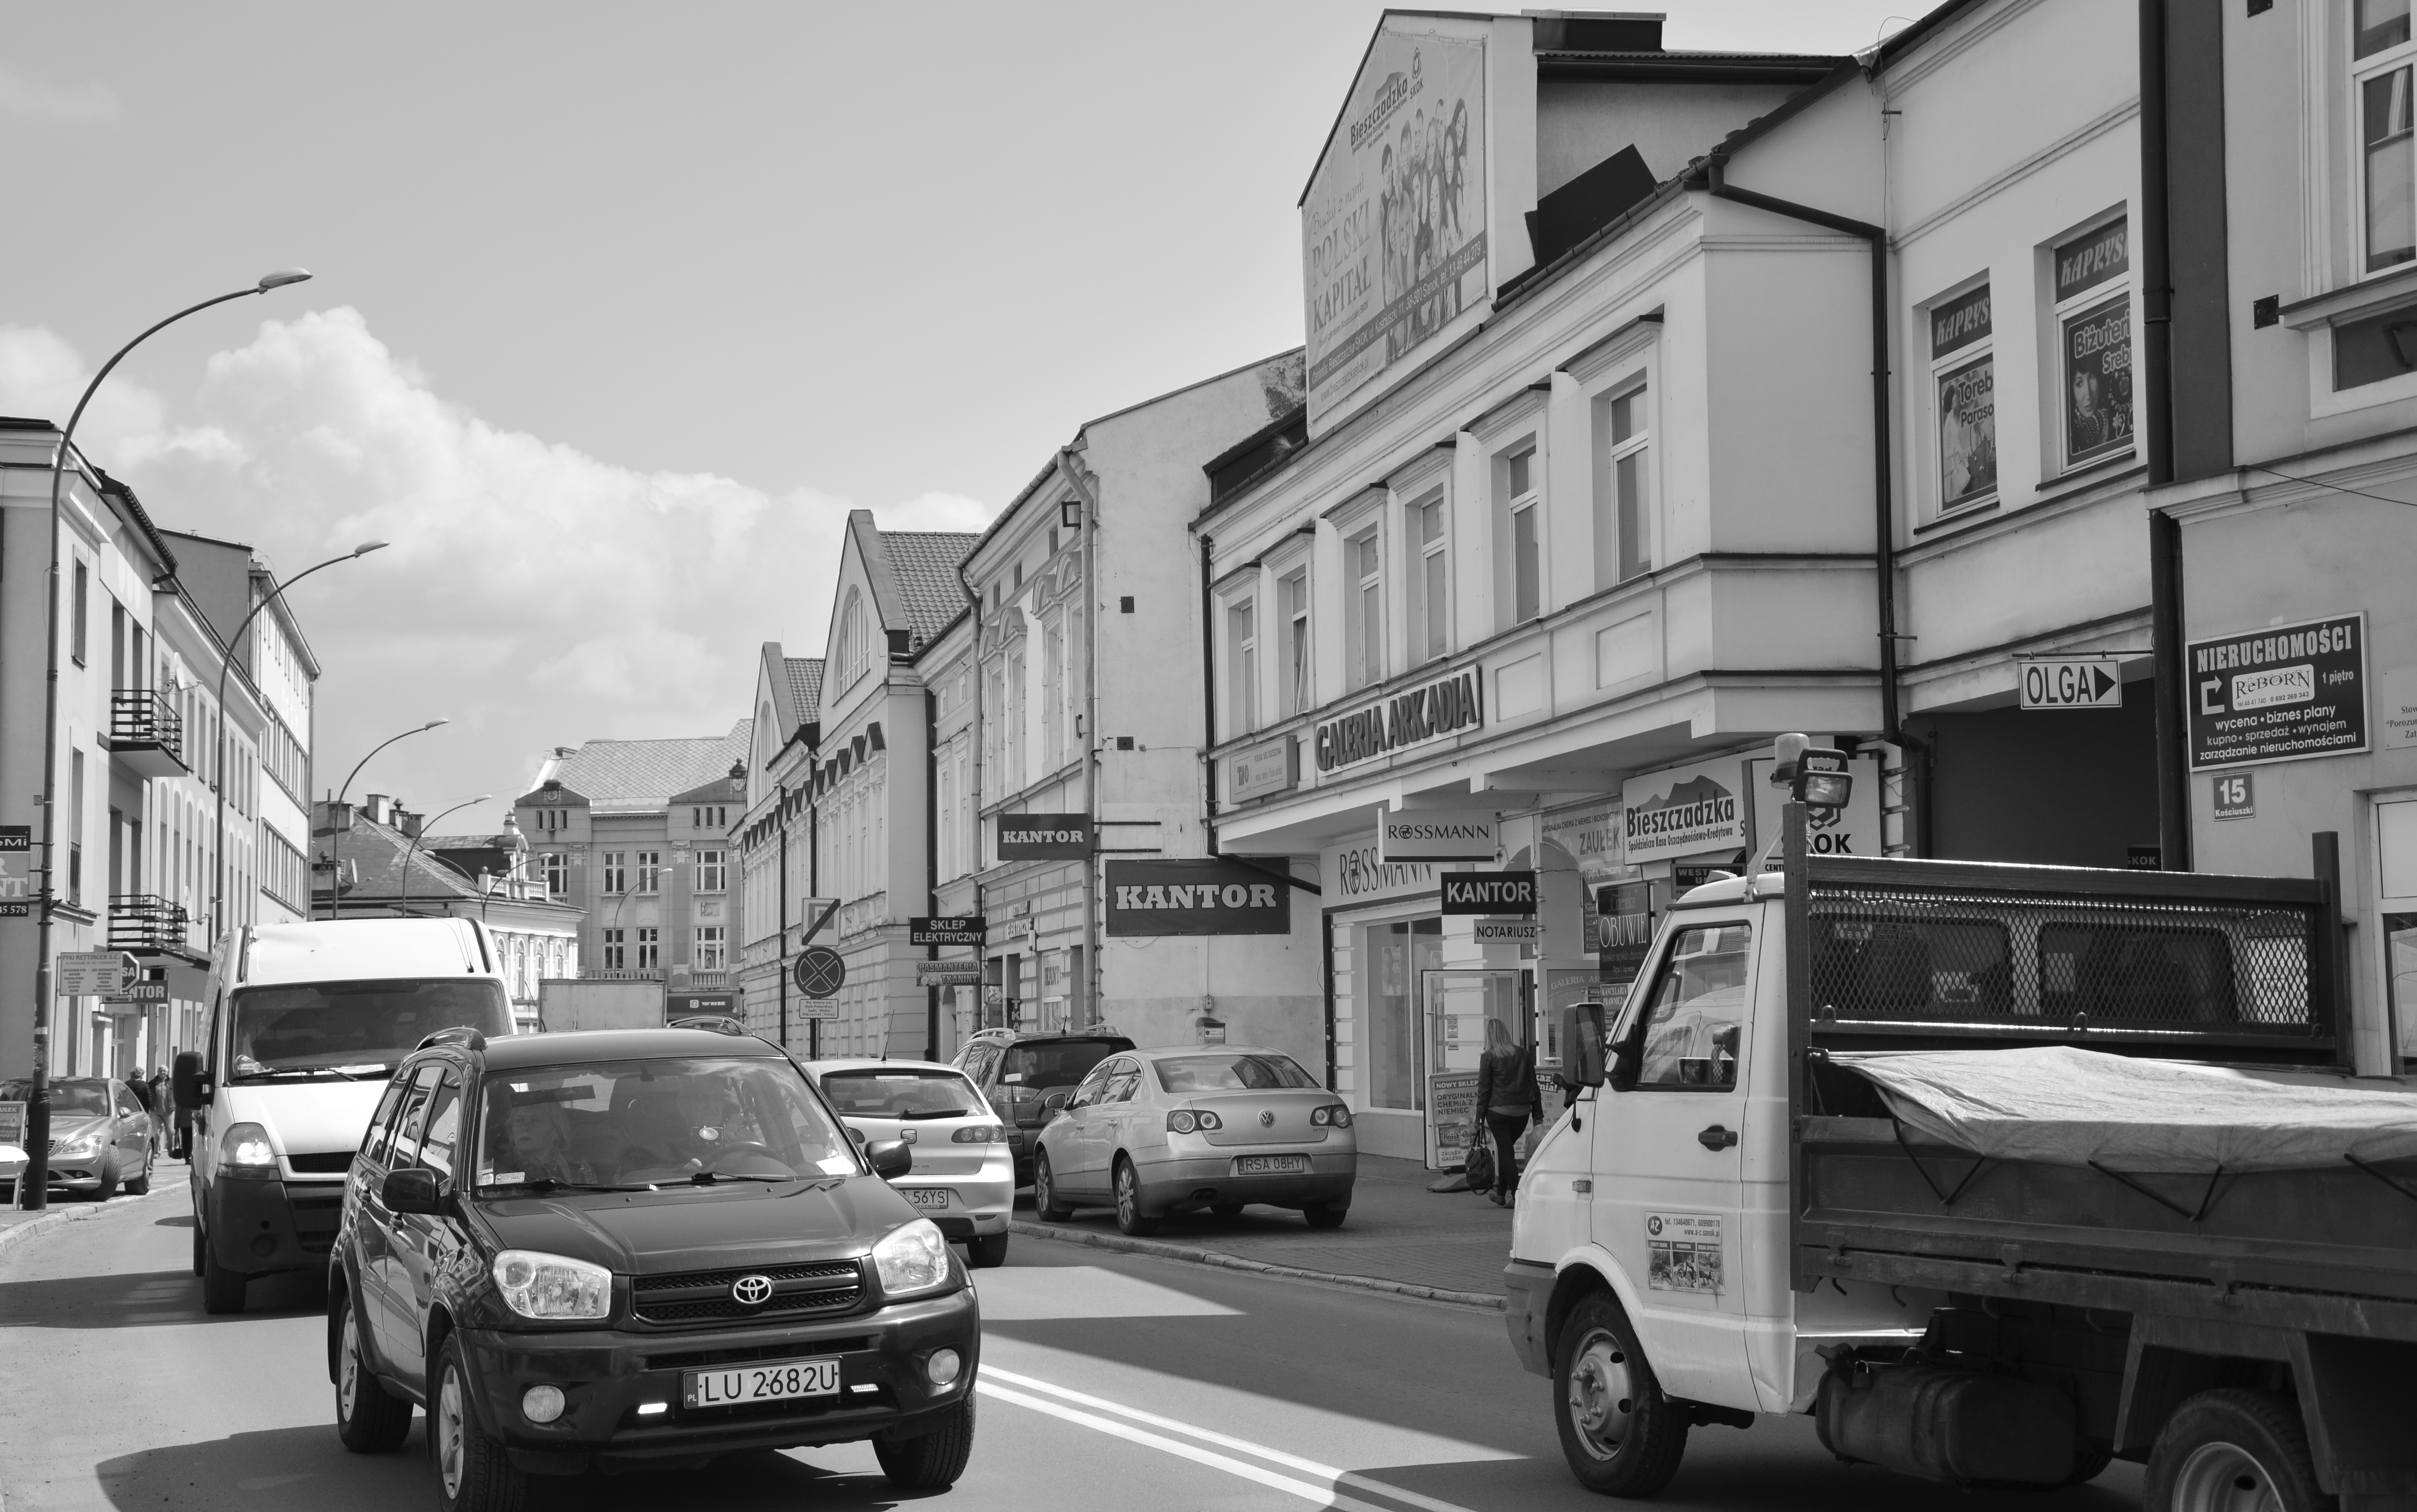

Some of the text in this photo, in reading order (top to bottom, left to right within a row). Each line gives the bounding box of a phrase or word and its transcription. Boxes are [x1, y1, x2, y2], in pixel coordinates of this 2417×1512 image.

[1410, 77, 1423, 100] SKOK
[1351, 77, 1407, 147] Bieszczadzka
[1312, 197, 1370, 278] POLSKI
[1471, 241, 1481, 261] 279
[1313, 255, 1371, 334] KAPITAŁ
[1936, 297, 1992, 347] KAPRYS
[1958, 370, 1993, 405] Toreb
[1961, 404, 1994, 428] Paraso
[2197, 623, 2351, 673] NIERUCHOMOŚCI
[2027, 665, 2093, 704] OLGA
[2322, 670, 2354, 685] 1 piętro
[1315, 673, 1477, 771] GALERIA ARKADIA
[2215, 705, 2336, 732] wycena biznes plany
[2207, 720, 2346, 747] kupno sprzedaż wynajem
[2200, 732, 2356, 760] zarządzanie nieruchomościami
[2219, 778, 2246, 804] 15
[1627, 789, 1735, 838] Bieszczadzka
[2215, 806, 2253, 817] Kościuszki
[1388, 824, 1489, 839] ROSSMANN
[1541, 822, 1562, 833] ORYGINALNA
[1561, 819, 1574, 829] CHEMIA
[1577, 816, 1591, 826] NIEMIEC
[1003, 830, 1084, 843] KANTOR
[1579, 827, 1620, 855] ZAUŁEK
[1629, 837, 1655, 854] Spółdzielcza
[1656, 836, 1667, 847] Kasa
[1668, 826, 1733, 847] Oszczędnościowo-Kredytowa
[1116, 884, 1277, 910] KANTOR
[1446, 881, 1532, 902] KANTOR
[10, 905, 27, 914] 578
[930, 920, 966, 930] SKLEP
[1476, 926, 1535, 938] NOTARIUSZ
[1599, 911, 1647, 948] OBUWIE
[914, 932, 983, 942] ELEKTRYCZNY
[919, 962, 979, 972] PASMANTERIA
[1045, 965, 1060, 986] KANT
[941, 974, 978, 983] TKANINY
[1551, 976, 1584, 989] GALERIA
[129, 985, 164, 998] NTOR
[1602, 986, 1627, 995] KANCELARIA
[1603, 996, 1626, 1005] PRAWNICZA
[1436, 1092, 1479, 1100] ORYGINALN
[1438, 1107, 1469, 1115] NIEMIEC
[1245, 1157, 1300, 1170] RSA 08HY
[913, 1190, 945, 1204] 56YS
[704, 1363, 836, 1402] LU 2682U
[687, 1394, 697, 1402] PL
